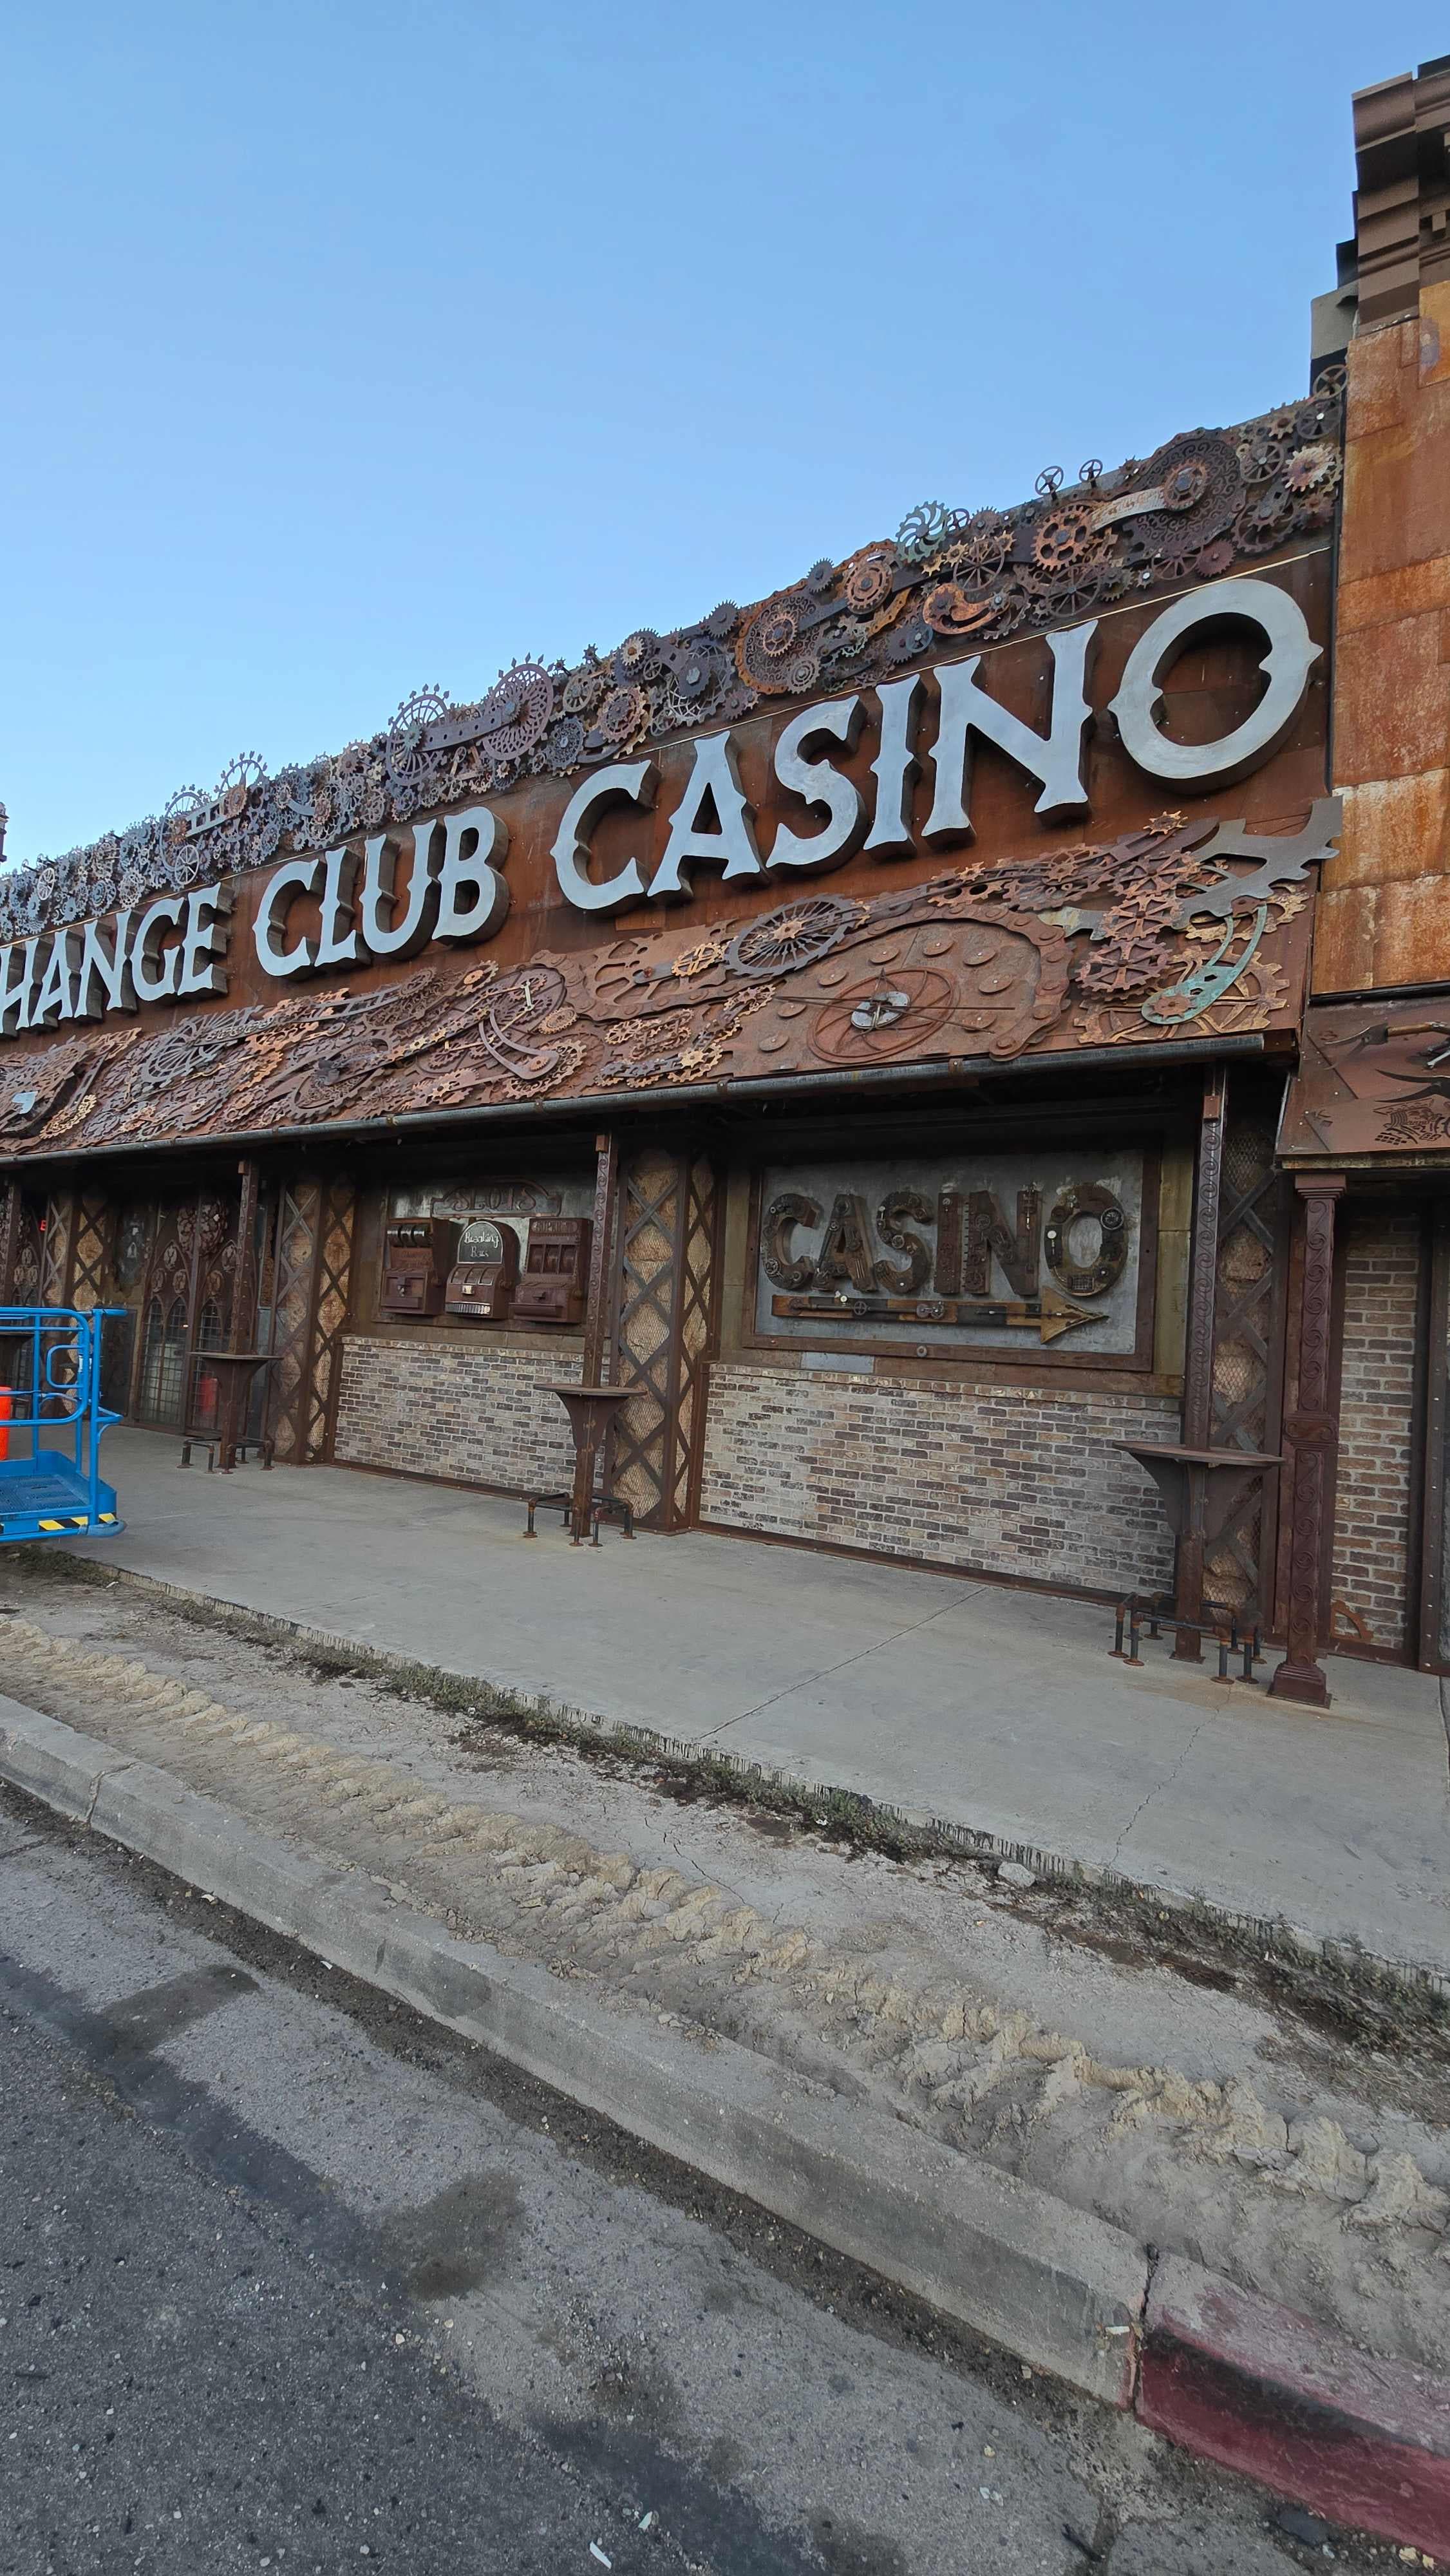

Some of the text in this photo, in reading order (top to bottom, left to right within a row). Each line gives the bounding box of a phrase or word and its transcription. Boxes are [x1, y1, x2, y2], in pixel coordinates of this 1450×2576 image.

[0, 578, 1324, 1034] HANGE CLUB CASINO
[761, 1182, 1129, 1298] CASINO
